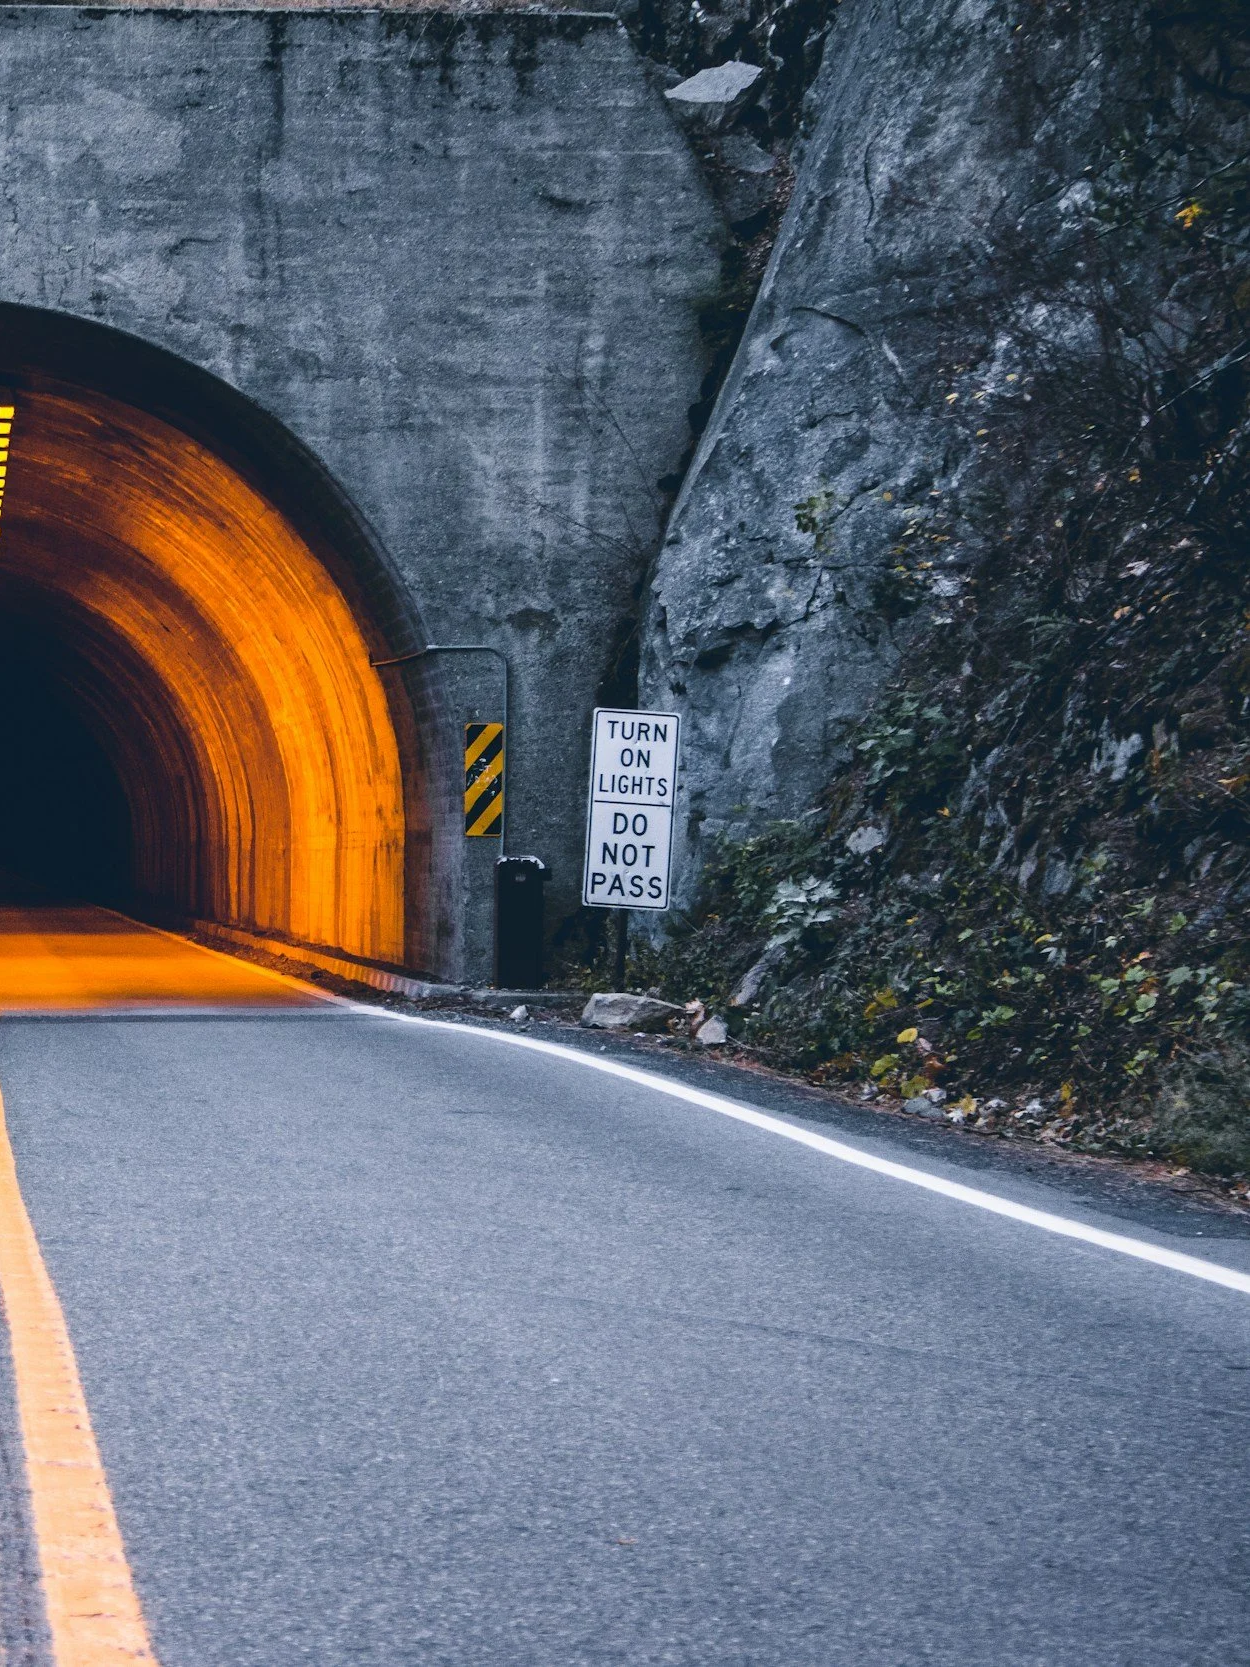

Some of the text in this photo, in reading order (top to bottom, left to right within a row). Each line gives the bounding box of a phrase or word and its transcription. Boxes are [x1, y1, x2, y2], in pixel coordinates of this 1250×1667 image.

[608, 720, 668, 743] TURN
[620, 748, 650, 768] ON
[599, 773, 668, 797] LIGHTS
[612, 812, 648, 836] DO
[601, 842, 656, 868] NOT
[590, 872, 662, 899] PASS
